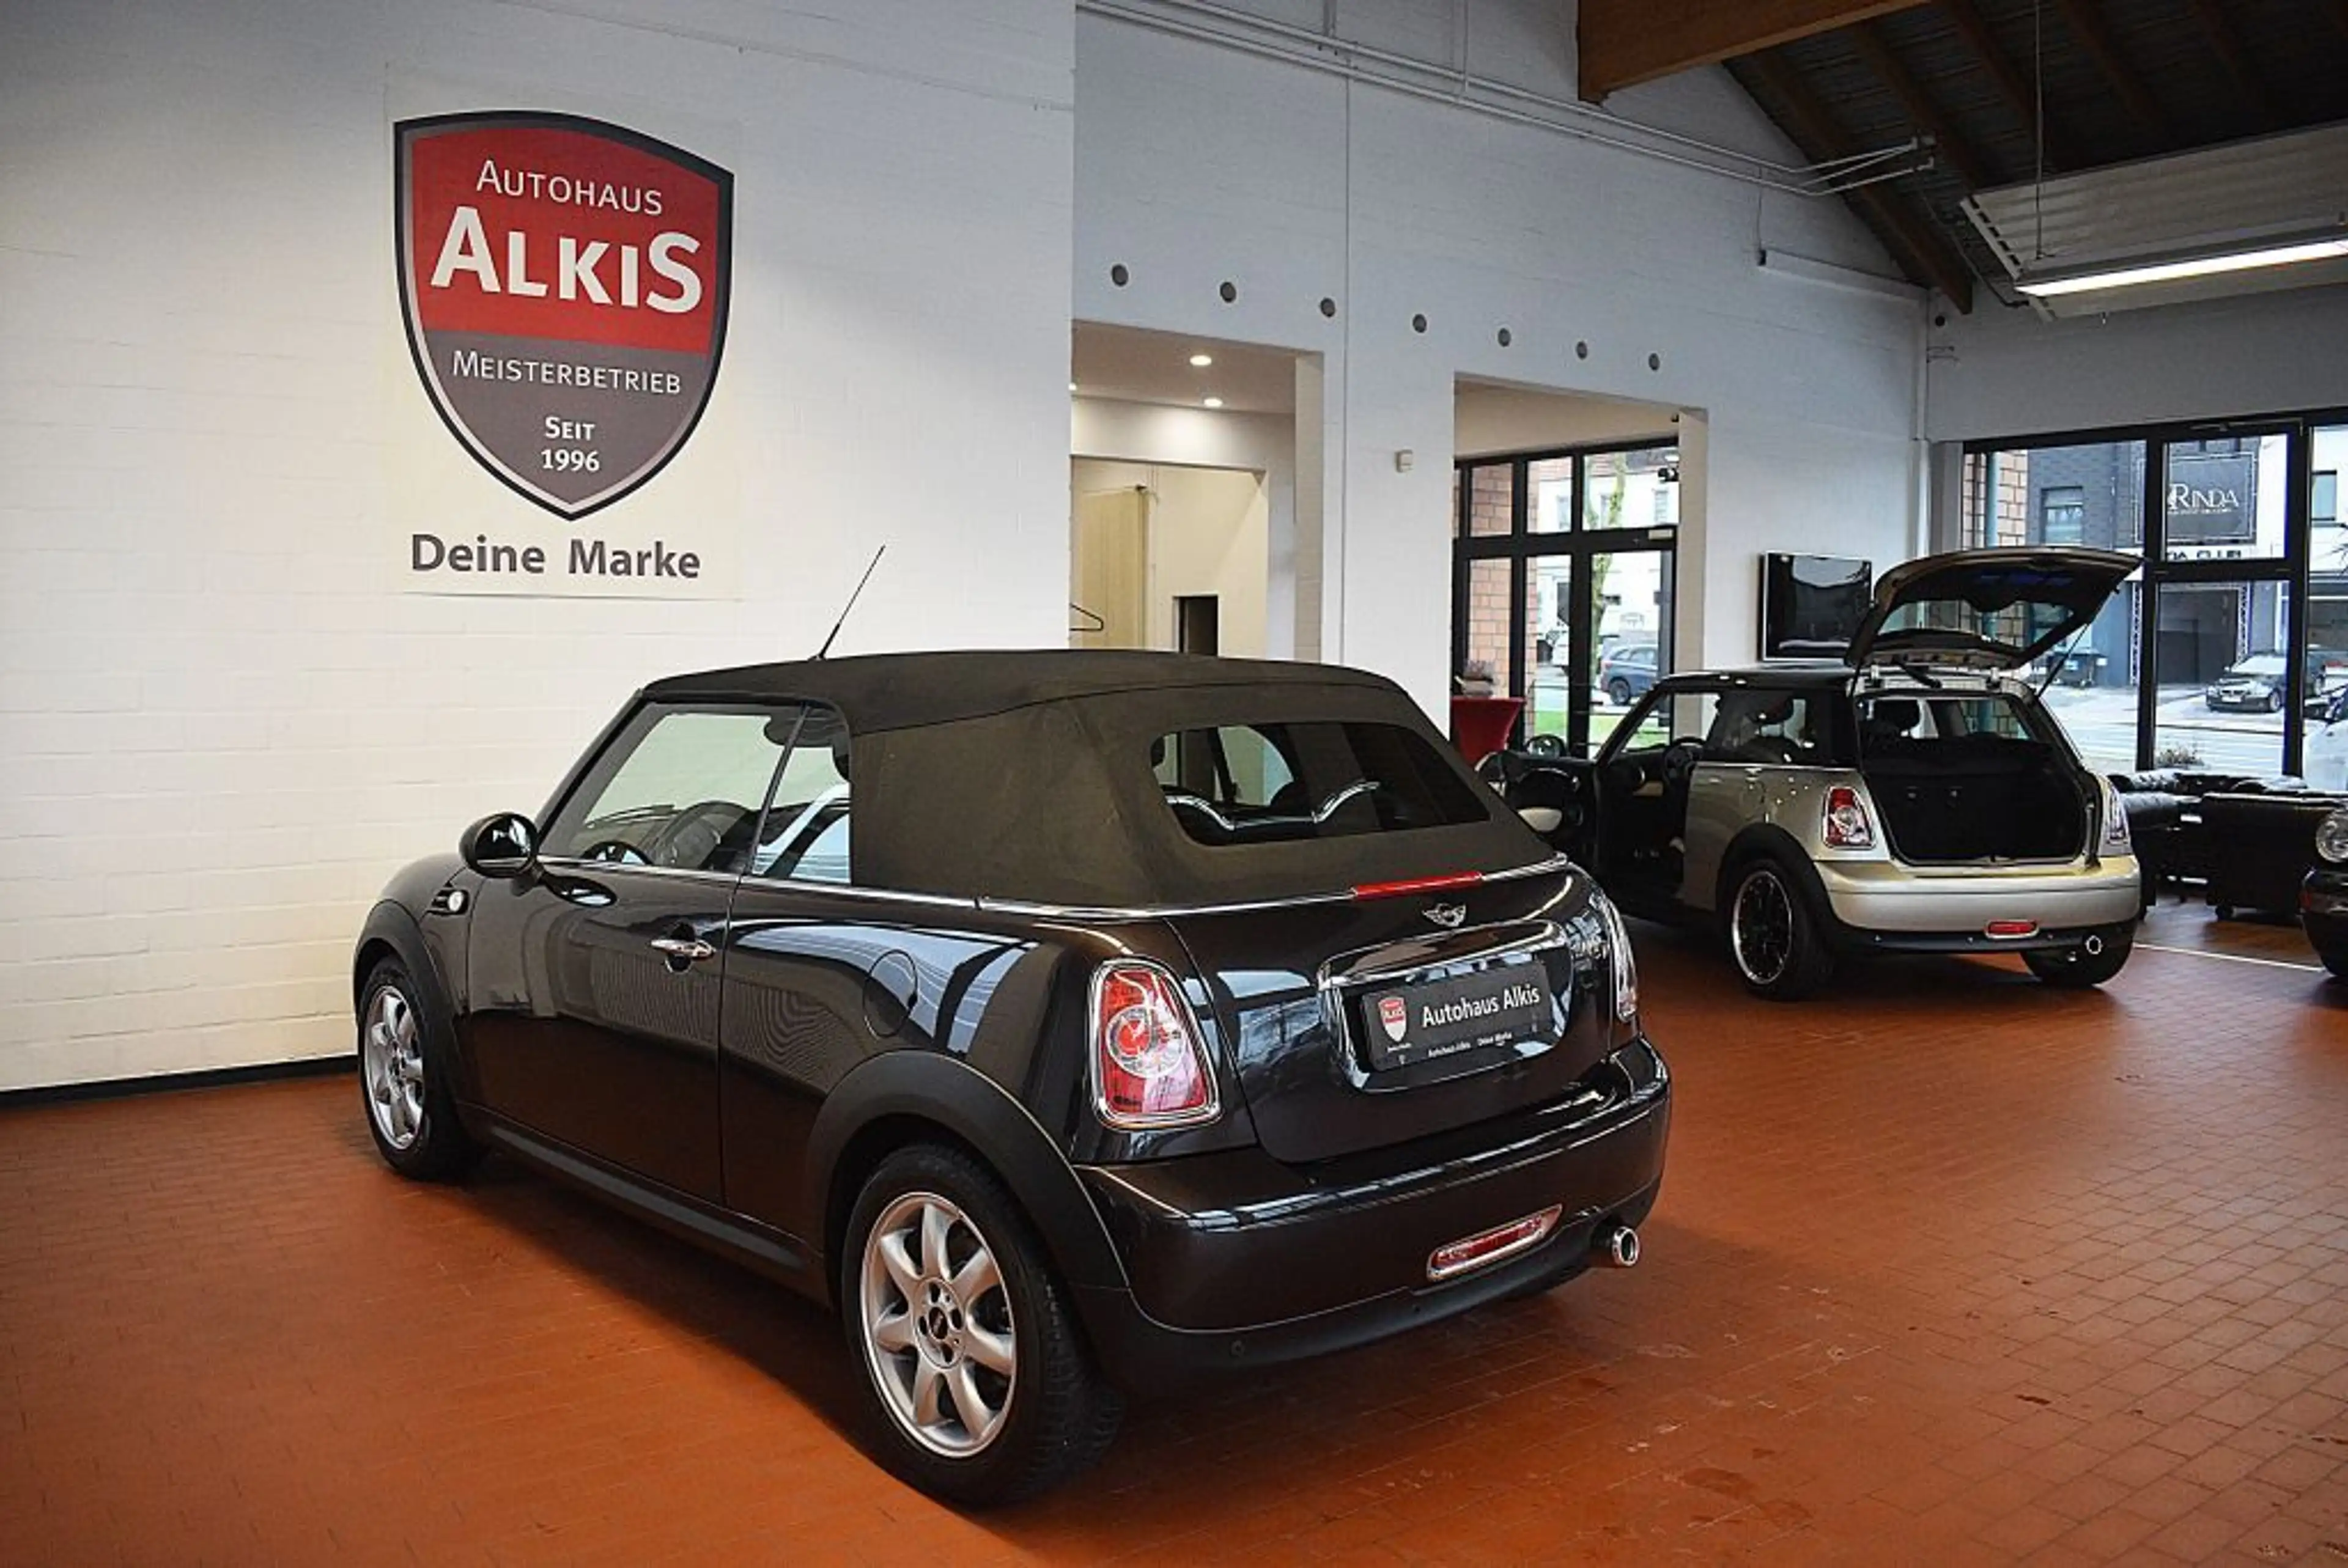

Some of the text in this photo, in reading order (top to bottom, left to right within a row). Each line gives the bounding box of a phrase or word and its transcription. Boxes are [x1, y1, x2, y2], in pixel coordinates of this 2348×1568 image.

[476, 160, 663, 216] AUTOHAUS
[453, 350, 681, 394] MEISTERBETRIEB
[545, 416, 596, 441] SEIT
[541, 449, 600, 473] 1996
[412, 534, 701, 579] Deine Marke
[1422, 996, 1499, 1028] Autohaus
[1503, 984, 1541, 1010] Alkis
